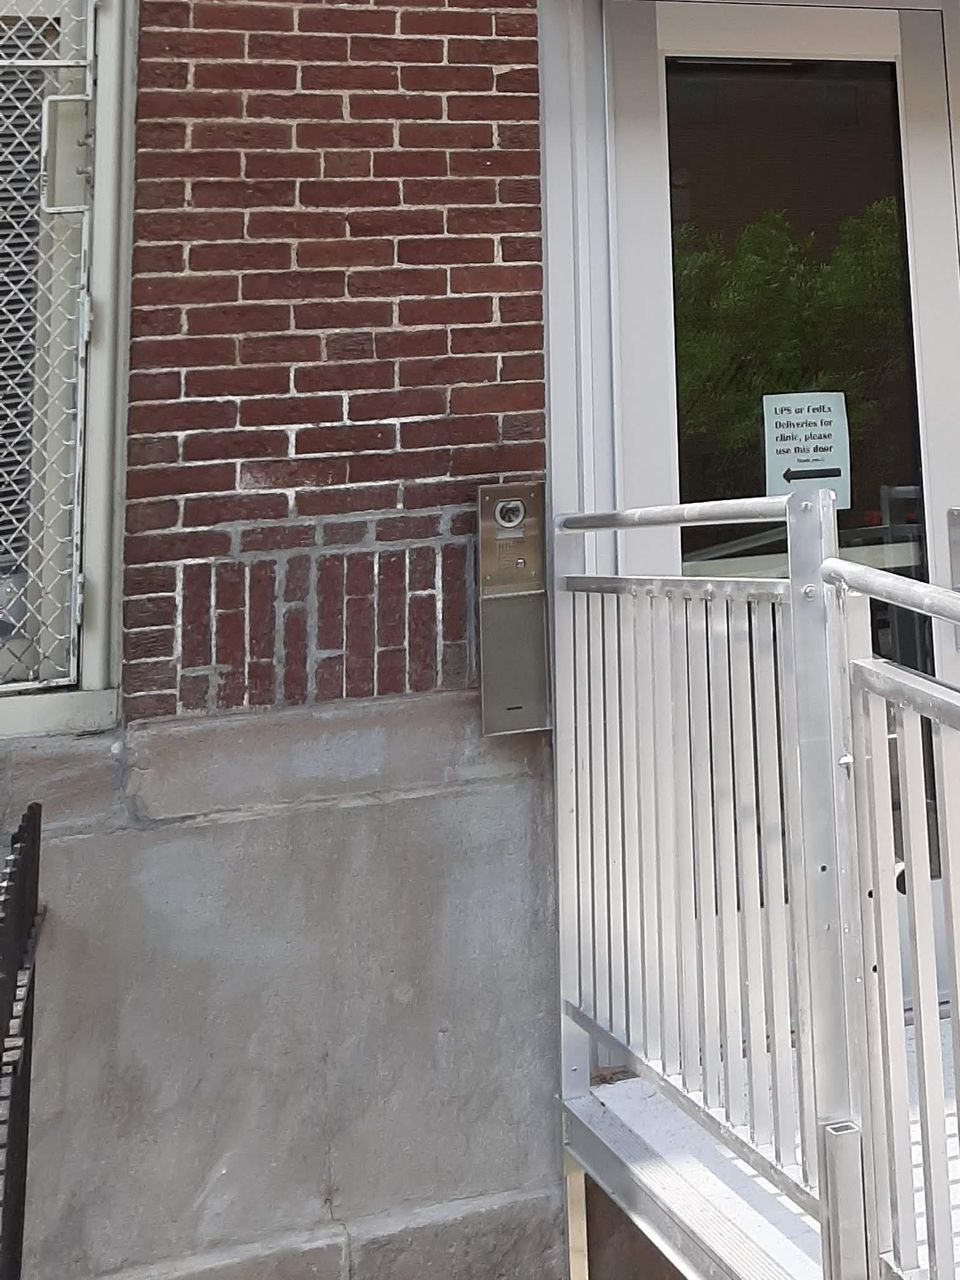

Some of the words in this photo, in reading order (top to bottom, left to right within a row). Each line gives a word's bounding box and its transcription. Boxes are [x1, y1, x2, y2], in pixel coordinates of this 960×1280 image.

[774, 406, 792, 415] UPS
[794, 407, 804, 415] or
[775, 419, 817, 429] Deliveries
[820, 419, 833, 427] for
[775, 432, 802, 442] clinic,
[804, 432, 832, 442] please
[813, 445, 833, 453] door
